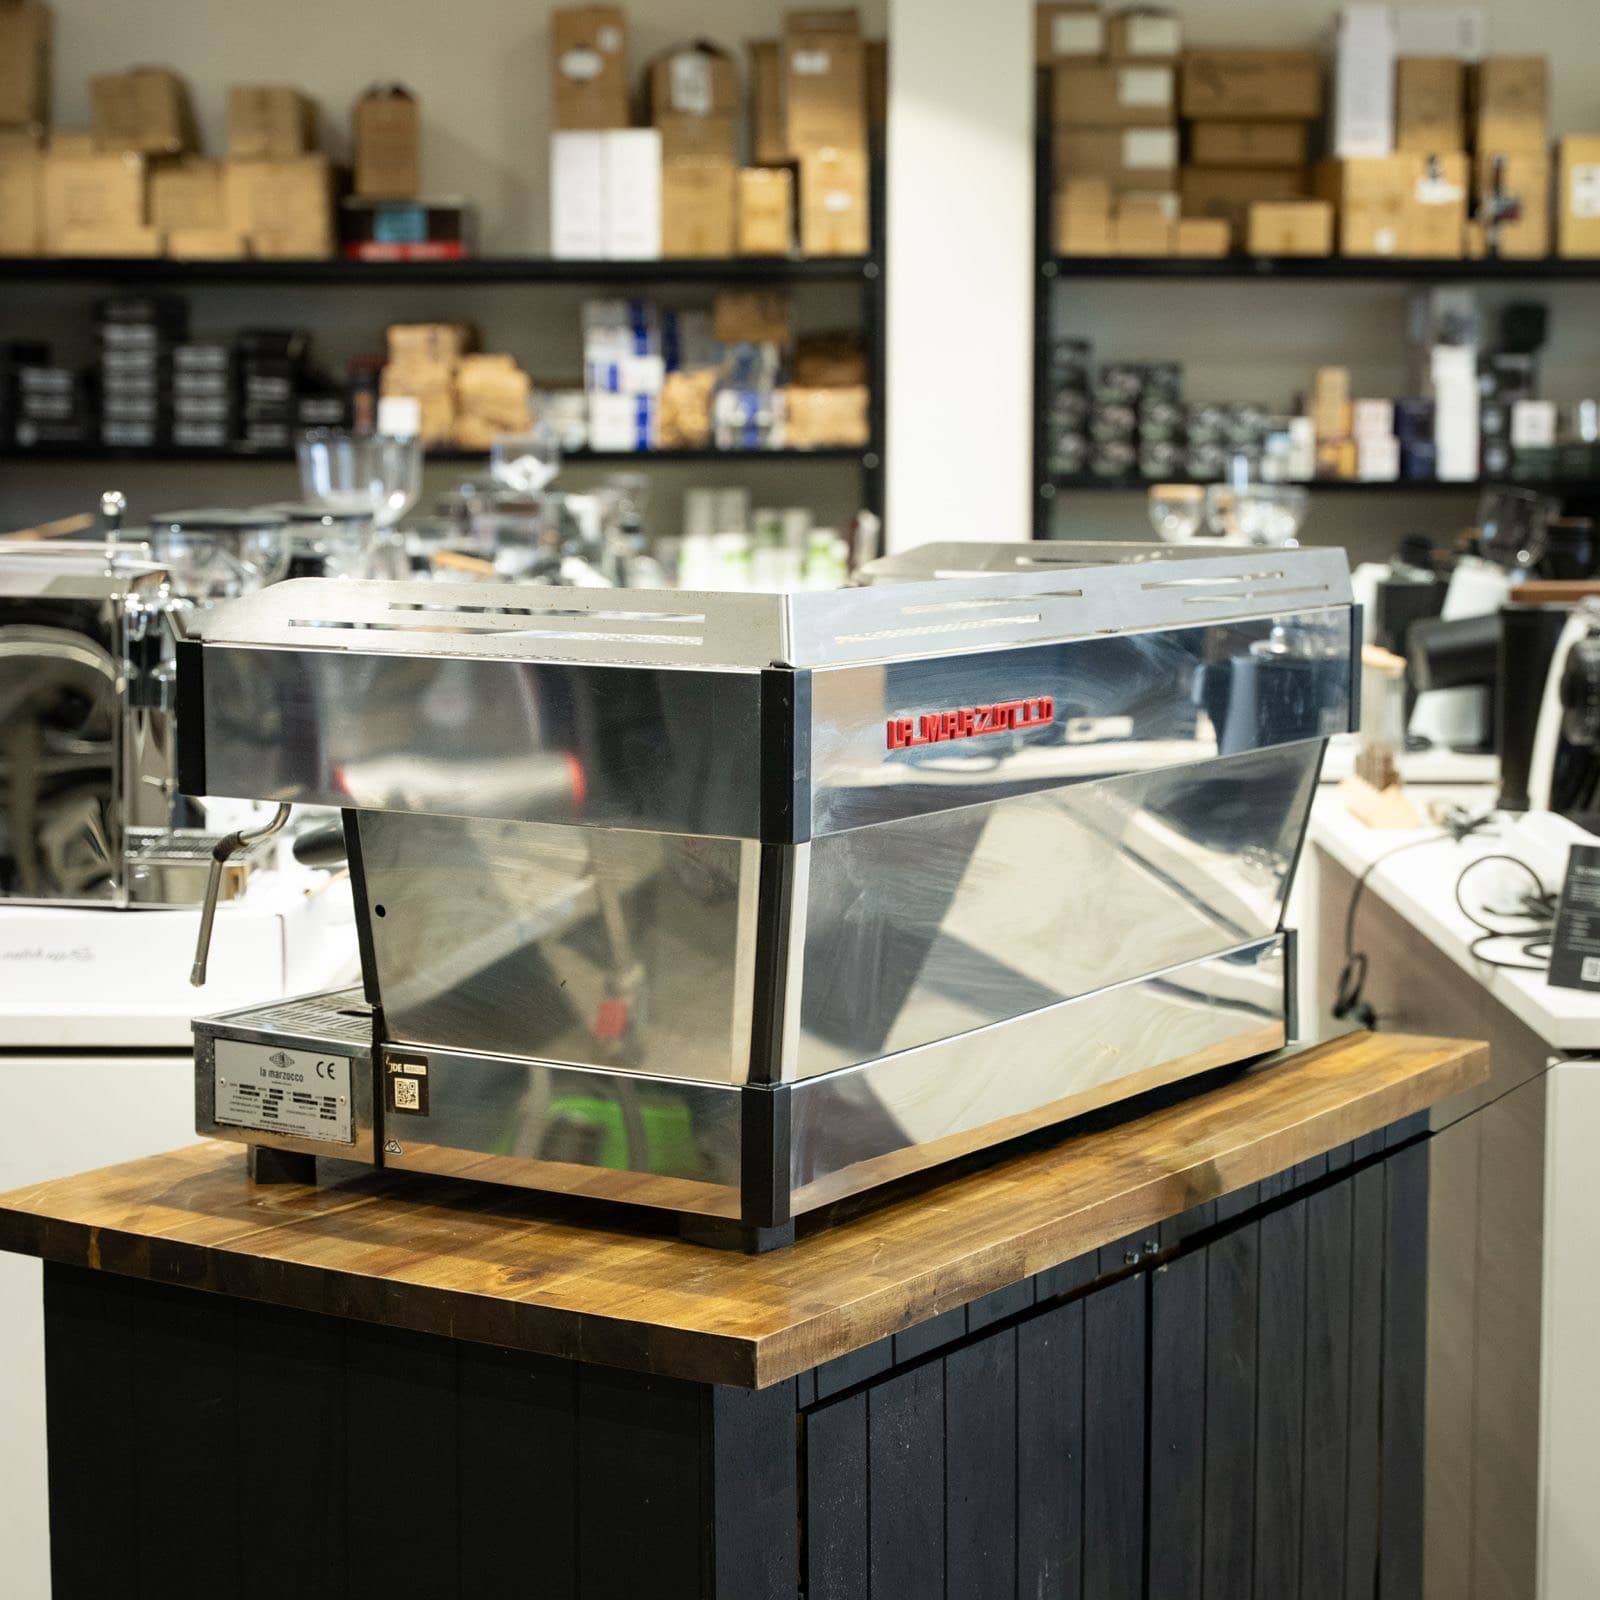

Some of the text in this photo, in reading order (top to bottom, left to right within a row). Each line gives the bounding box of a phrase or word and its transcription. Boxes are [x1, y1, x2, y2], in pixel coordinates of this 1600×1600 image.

[920, 696, 1054, 742] MARZOCCO
[259, 1066, 304, 1083] la marzocco
[316, 1060, 336, 1080] CE
